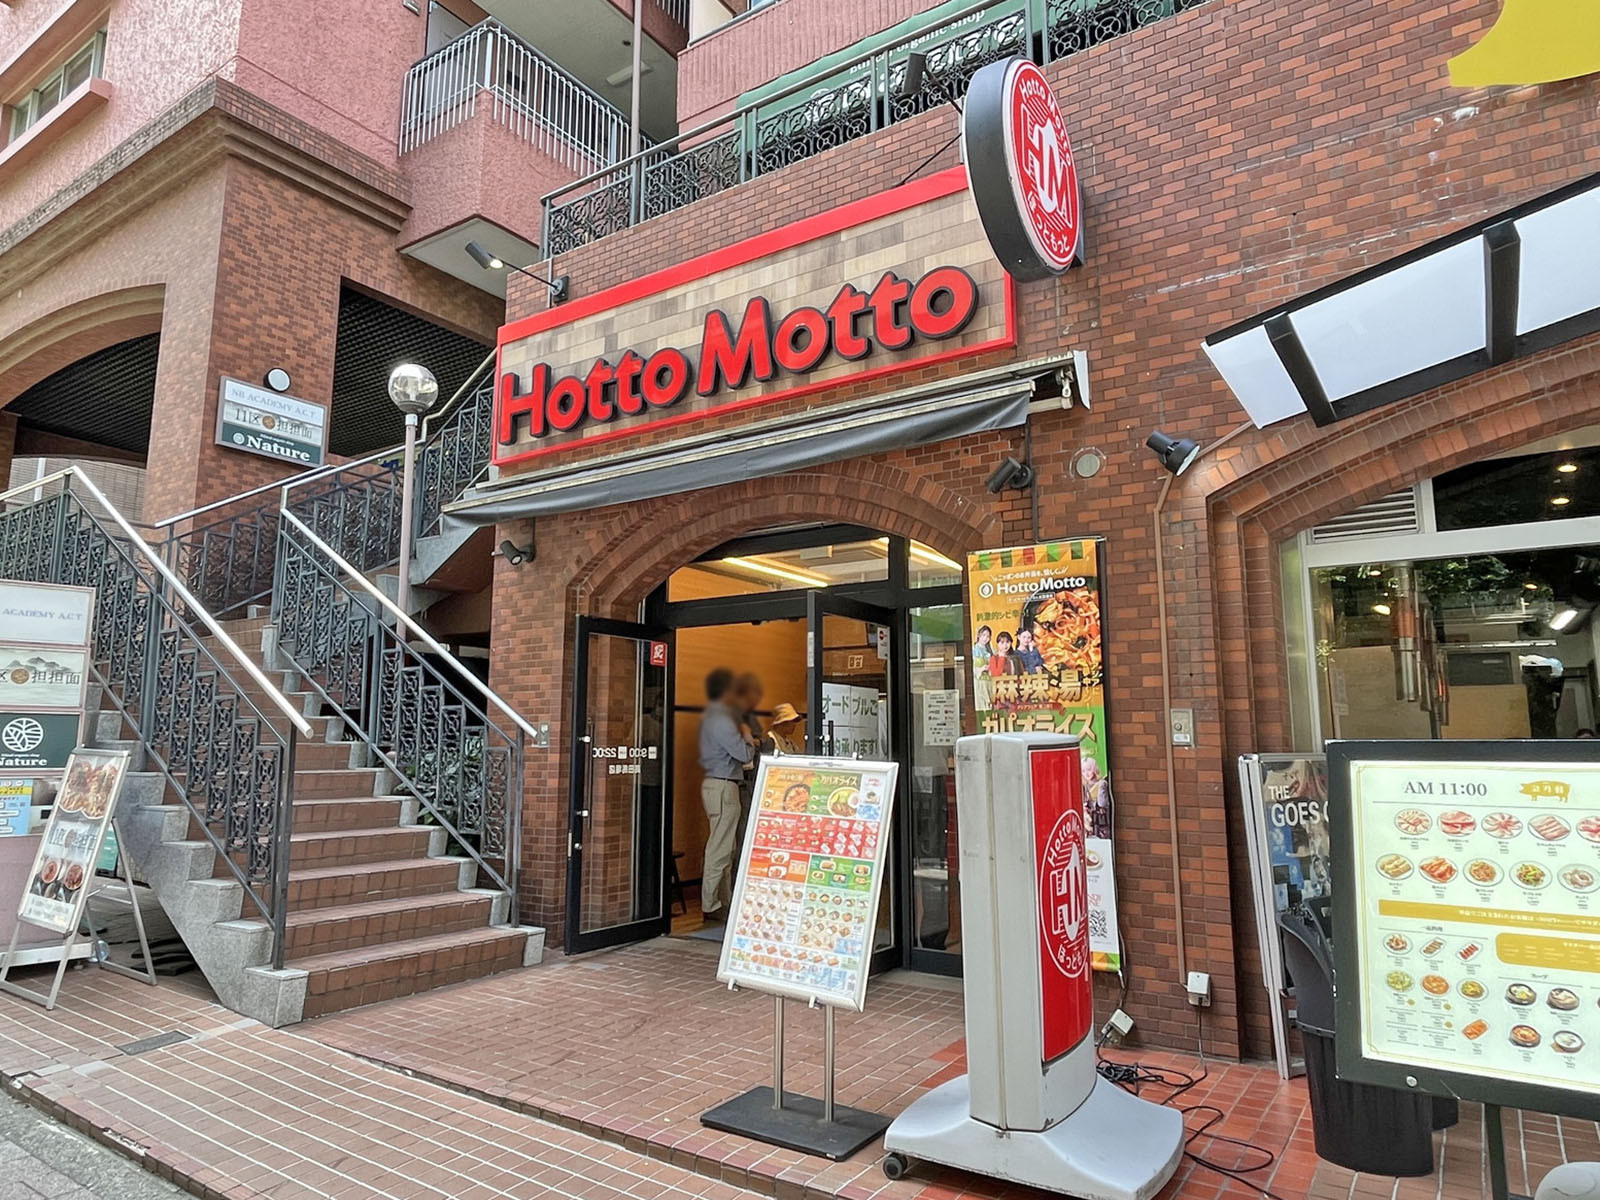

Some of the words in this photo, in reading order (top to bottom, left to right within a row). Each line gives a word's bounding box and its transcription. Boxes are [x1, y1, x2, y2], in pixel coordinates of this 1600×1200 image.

[1019, 78, 1046, 99] Hotto
[499, 346, 692, 445] Hotto
[696, 265, 980, 397] Motto
[247, 393, 294, 412] ACADEMY
[295, 407, 315, 418] ACT
[247, 435, 311, 462] Nature
[2, 608, 56, 620] ACADEMY
[58, 613, 83, 621] ACT
[32, 670, 81, 685] 担担面
[1268, 785, 1291, 801] THE
[1403, 781, 1434, 795] AM
[1439, 782, 1488, 797] 11:00
[1271, 800, 1321, 828] GOES
[1048, 822, 1072, 867] Hotto
